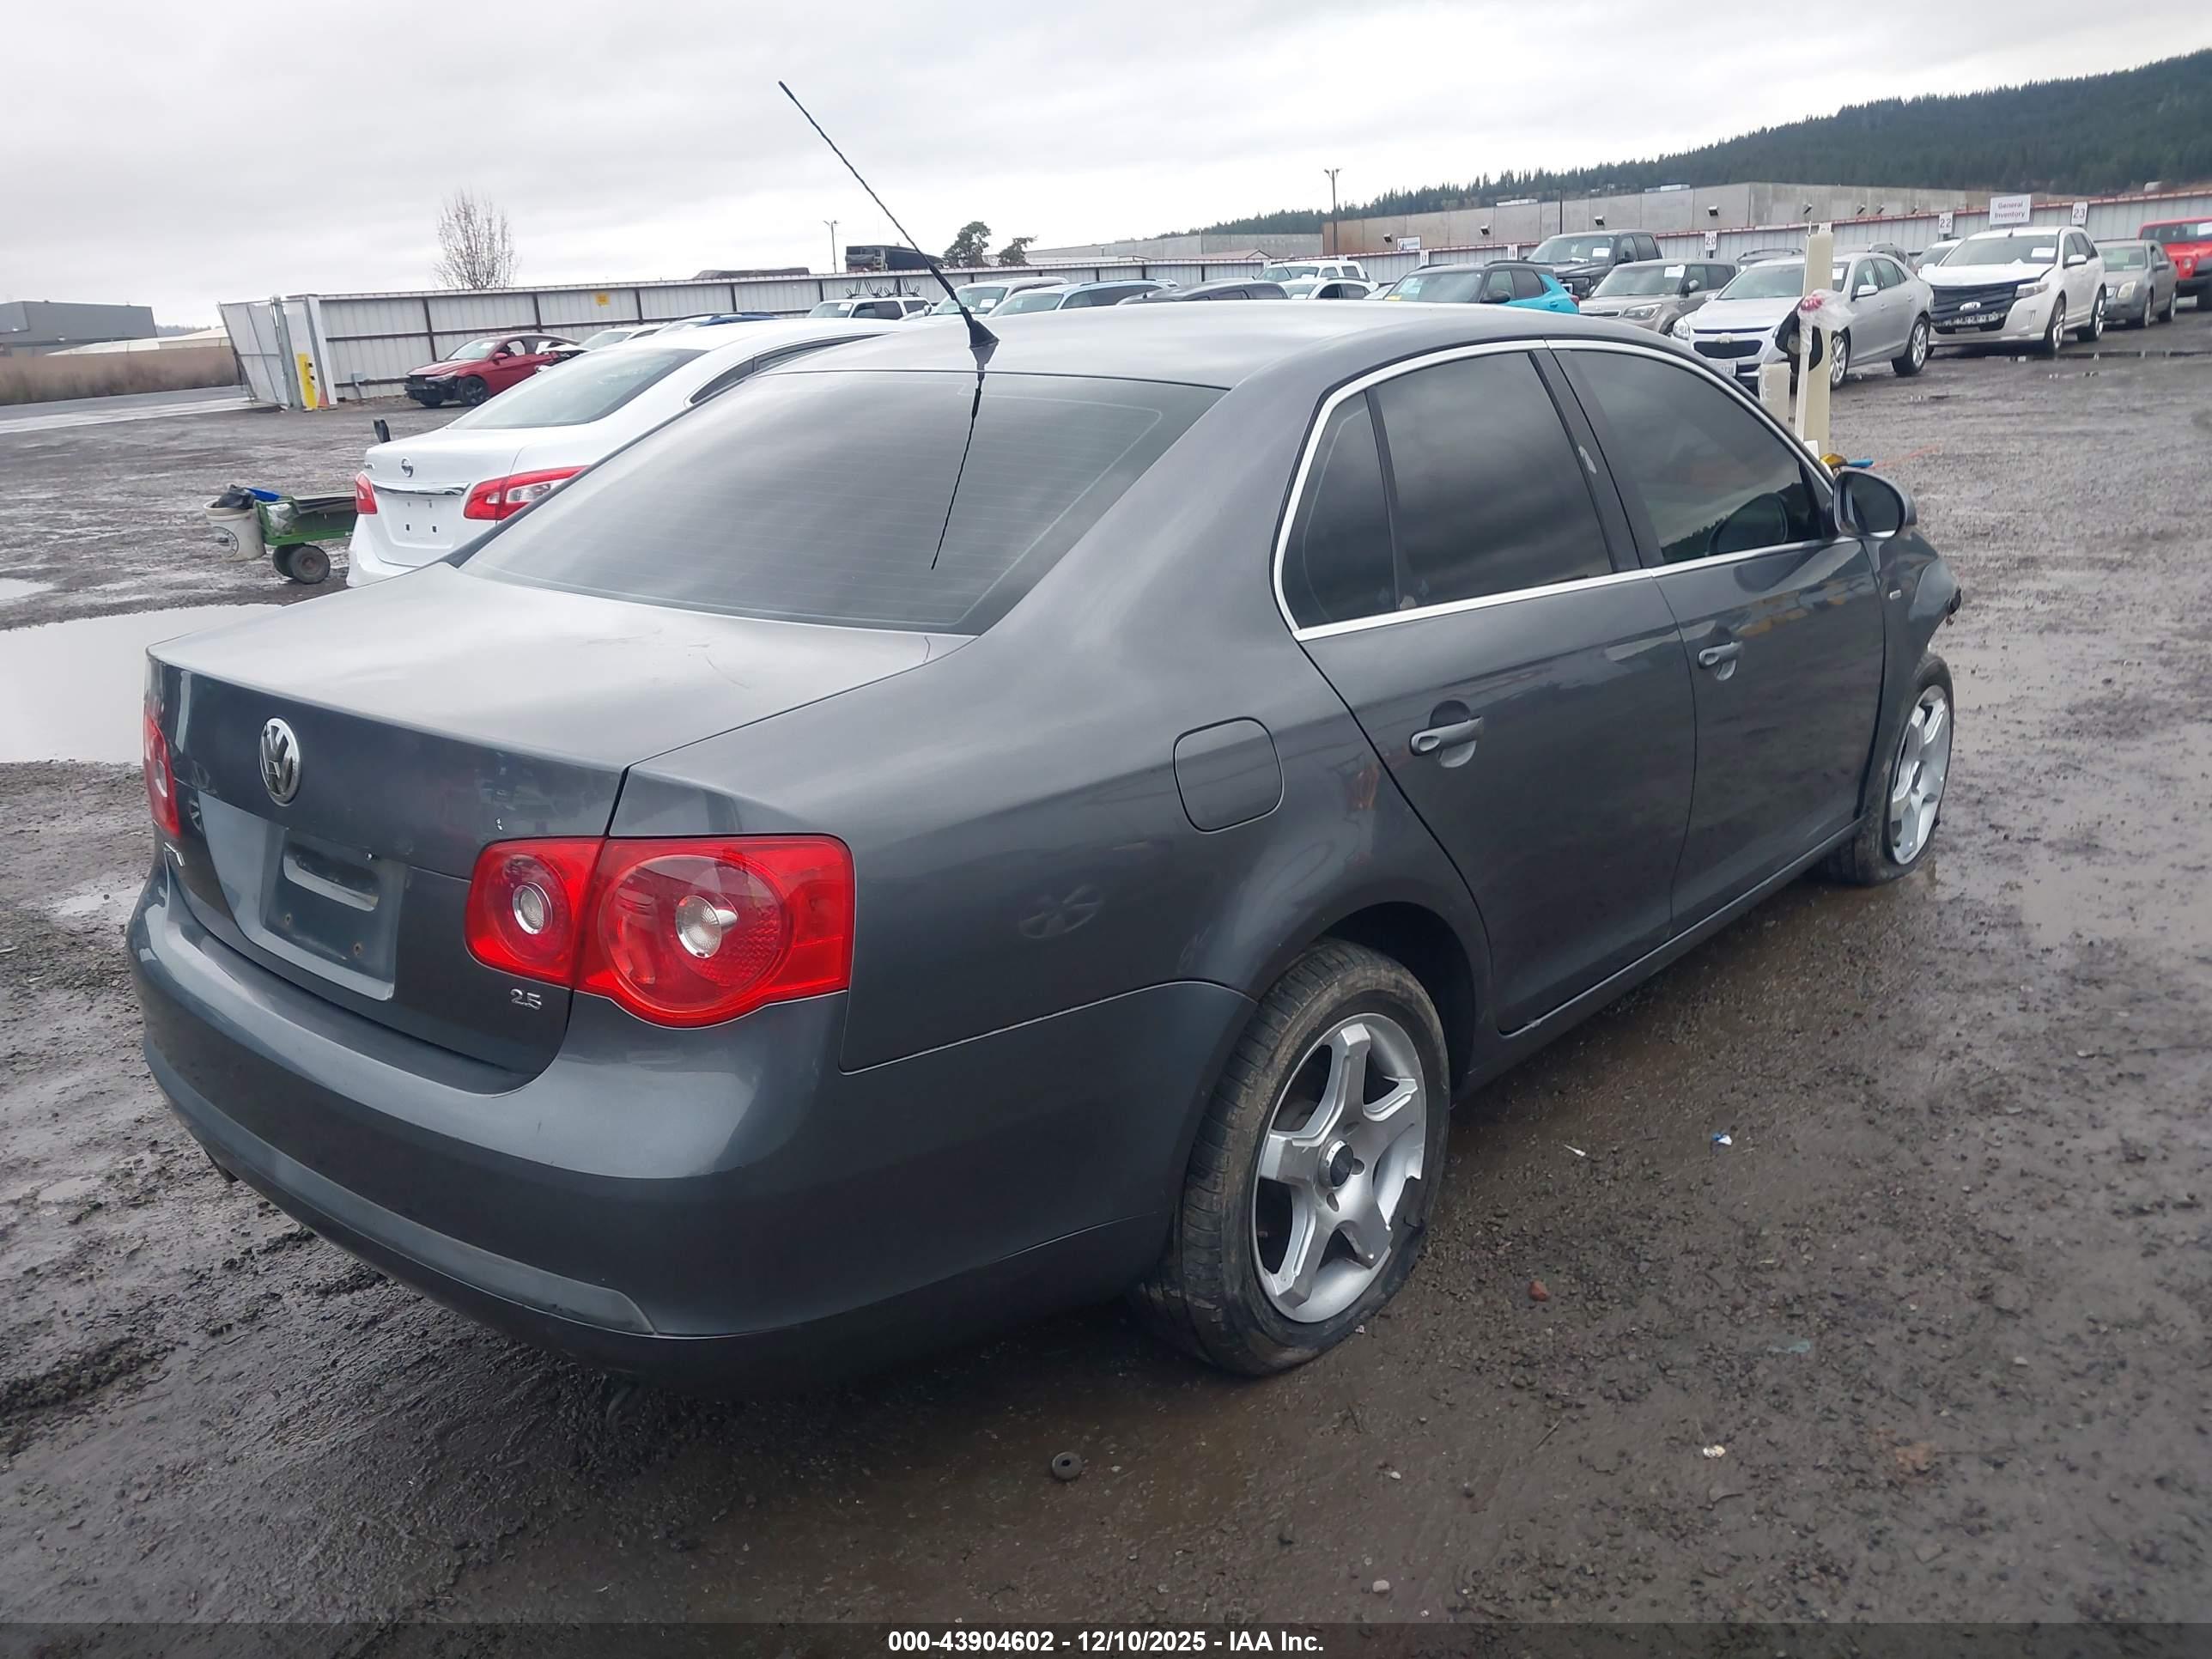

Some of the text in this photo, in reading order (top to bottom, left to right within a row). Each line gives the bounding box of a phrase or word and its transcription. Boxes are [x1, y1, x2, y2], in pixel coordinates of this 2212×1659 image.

[1997, 199, 2023, 210] General
[1994, 210, 2025, 220] Inventory
[2073, 208, 2085, 218] 23
[1940, 217, 1952, 228] 22
[1705, 235, 1717, 246] 20
